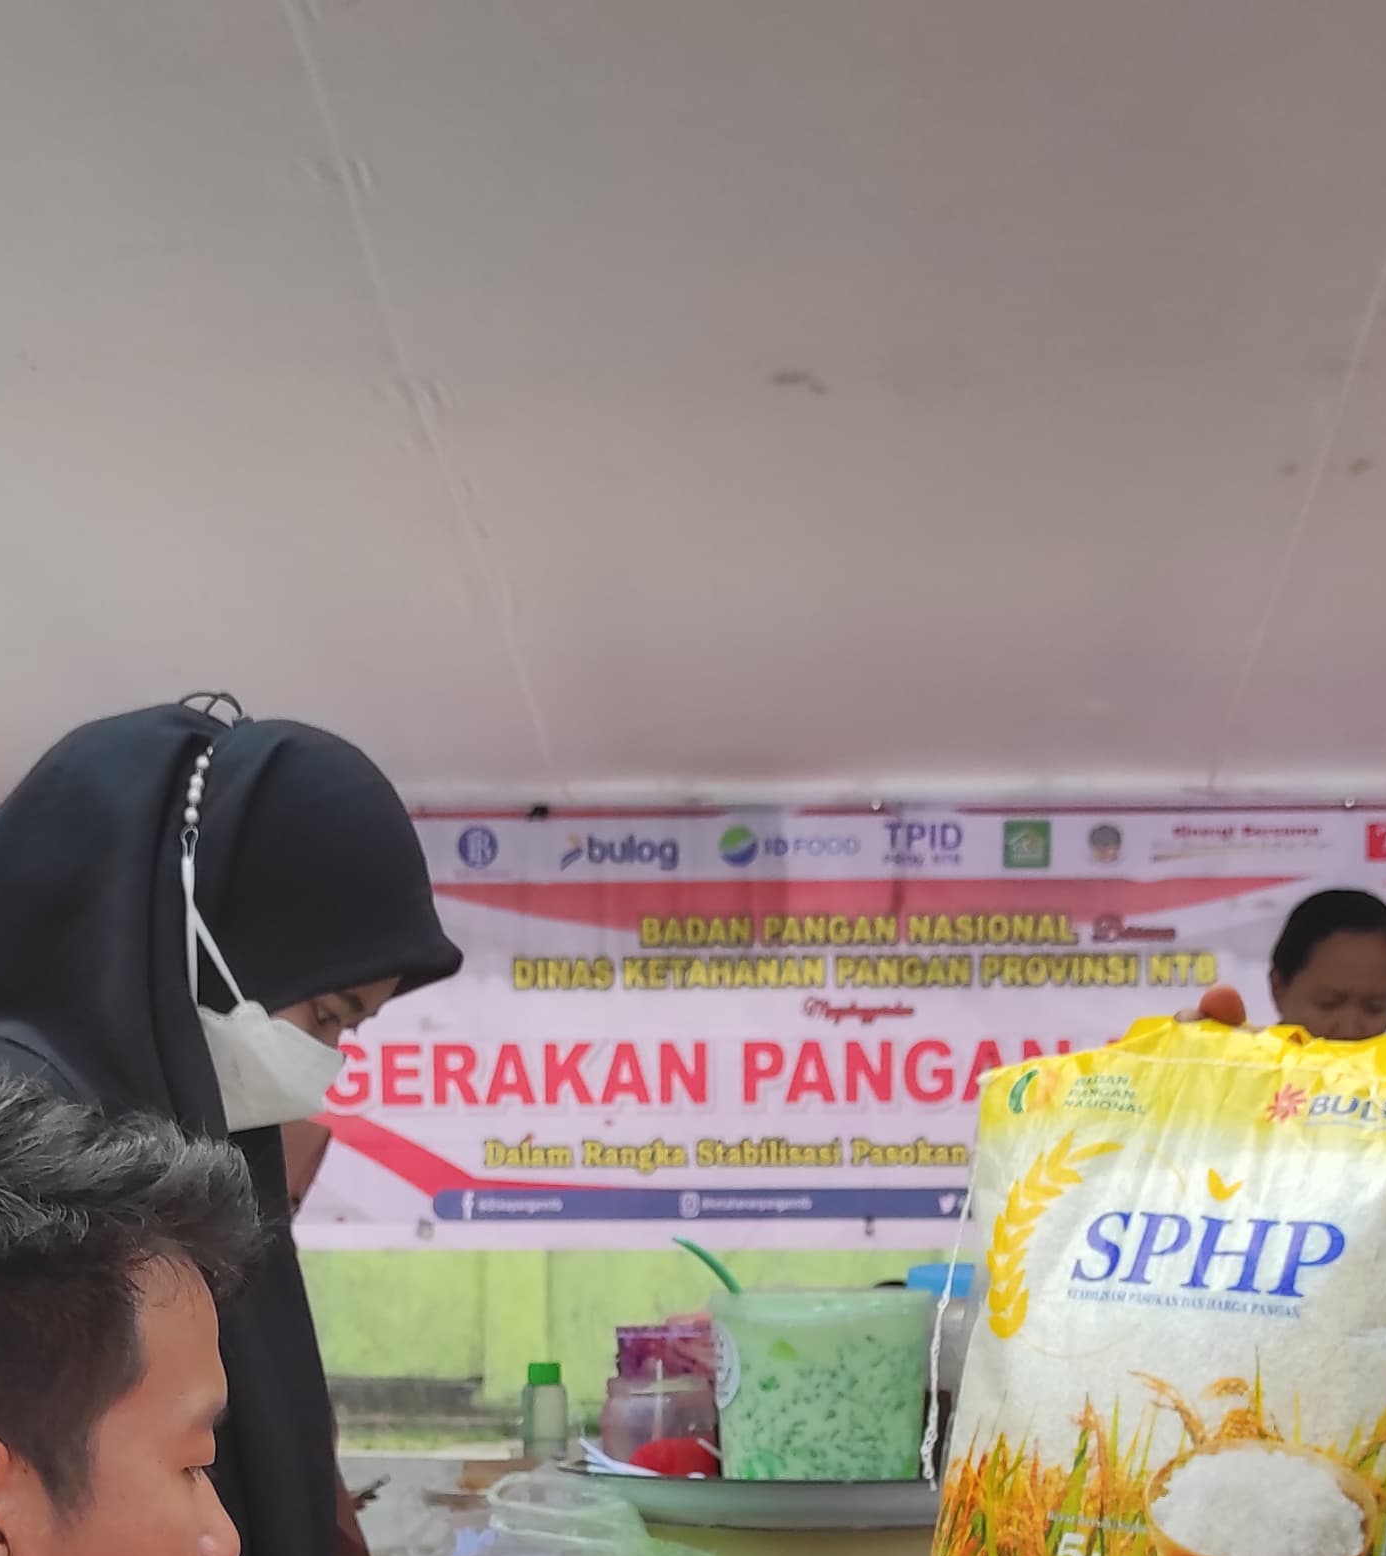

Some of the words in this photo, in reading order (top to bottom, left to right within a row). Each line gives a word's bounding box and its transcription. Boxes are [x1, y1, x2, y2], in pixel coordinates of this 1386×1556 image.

[586, 833, 679, 870] bulog
[884, 823, 963, 849] TPID
[640, 916, 754, 947] BADAN
[764, 915, 898, 946] PANGAN
[908, 914, 1078, 945] NASIONAL
[514, 956, 614, 990] DINAS
[622, 956, 826, 989] KETAHANAN
[835, 955, 972, 987] PANGAN
[980, 953, 1139, 987] PROVINSI
[1148, 952, 1218, 986] NTB
[325, 1041, 708, 1106] GERAKAN
[484, 1138, 572, 1168] Dalam
[582, 1138, 687, 1174] Rangka
[695, 1137, 843, 1168] Stabilisasi
[851, 1137, 970, 1168] Pasokan
[1071, 1211, 1346, 1298] SPHP
